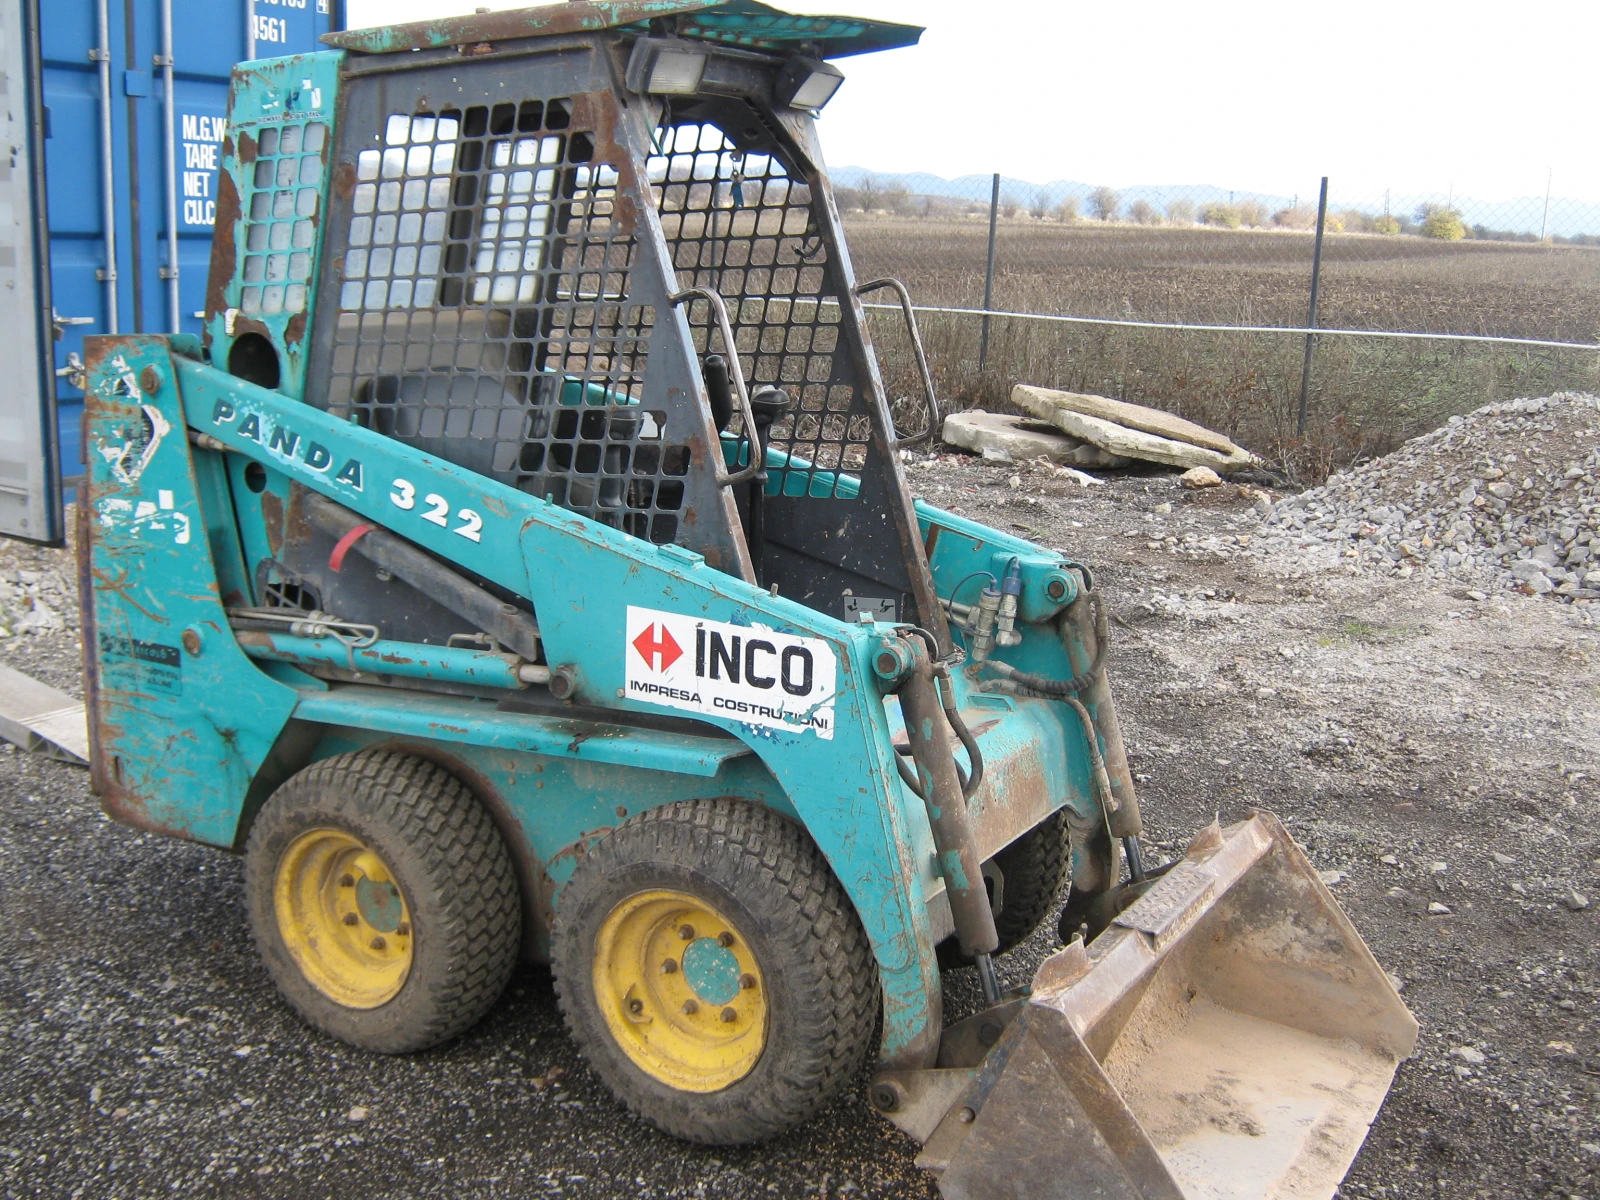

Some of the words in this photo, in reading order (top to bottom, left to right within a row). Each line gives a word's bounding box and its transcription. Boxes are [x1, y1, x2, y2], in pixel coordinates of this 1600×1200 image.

[183, 143, 218, 170] TARE
[183, 171, 211, 197] NET
[212, 397, 365, 493] PANDA
[389, 478, 484, 544] 322
[695, 626, 814, 697] INCO
[630, 679, 702, 704] IMPRESA
